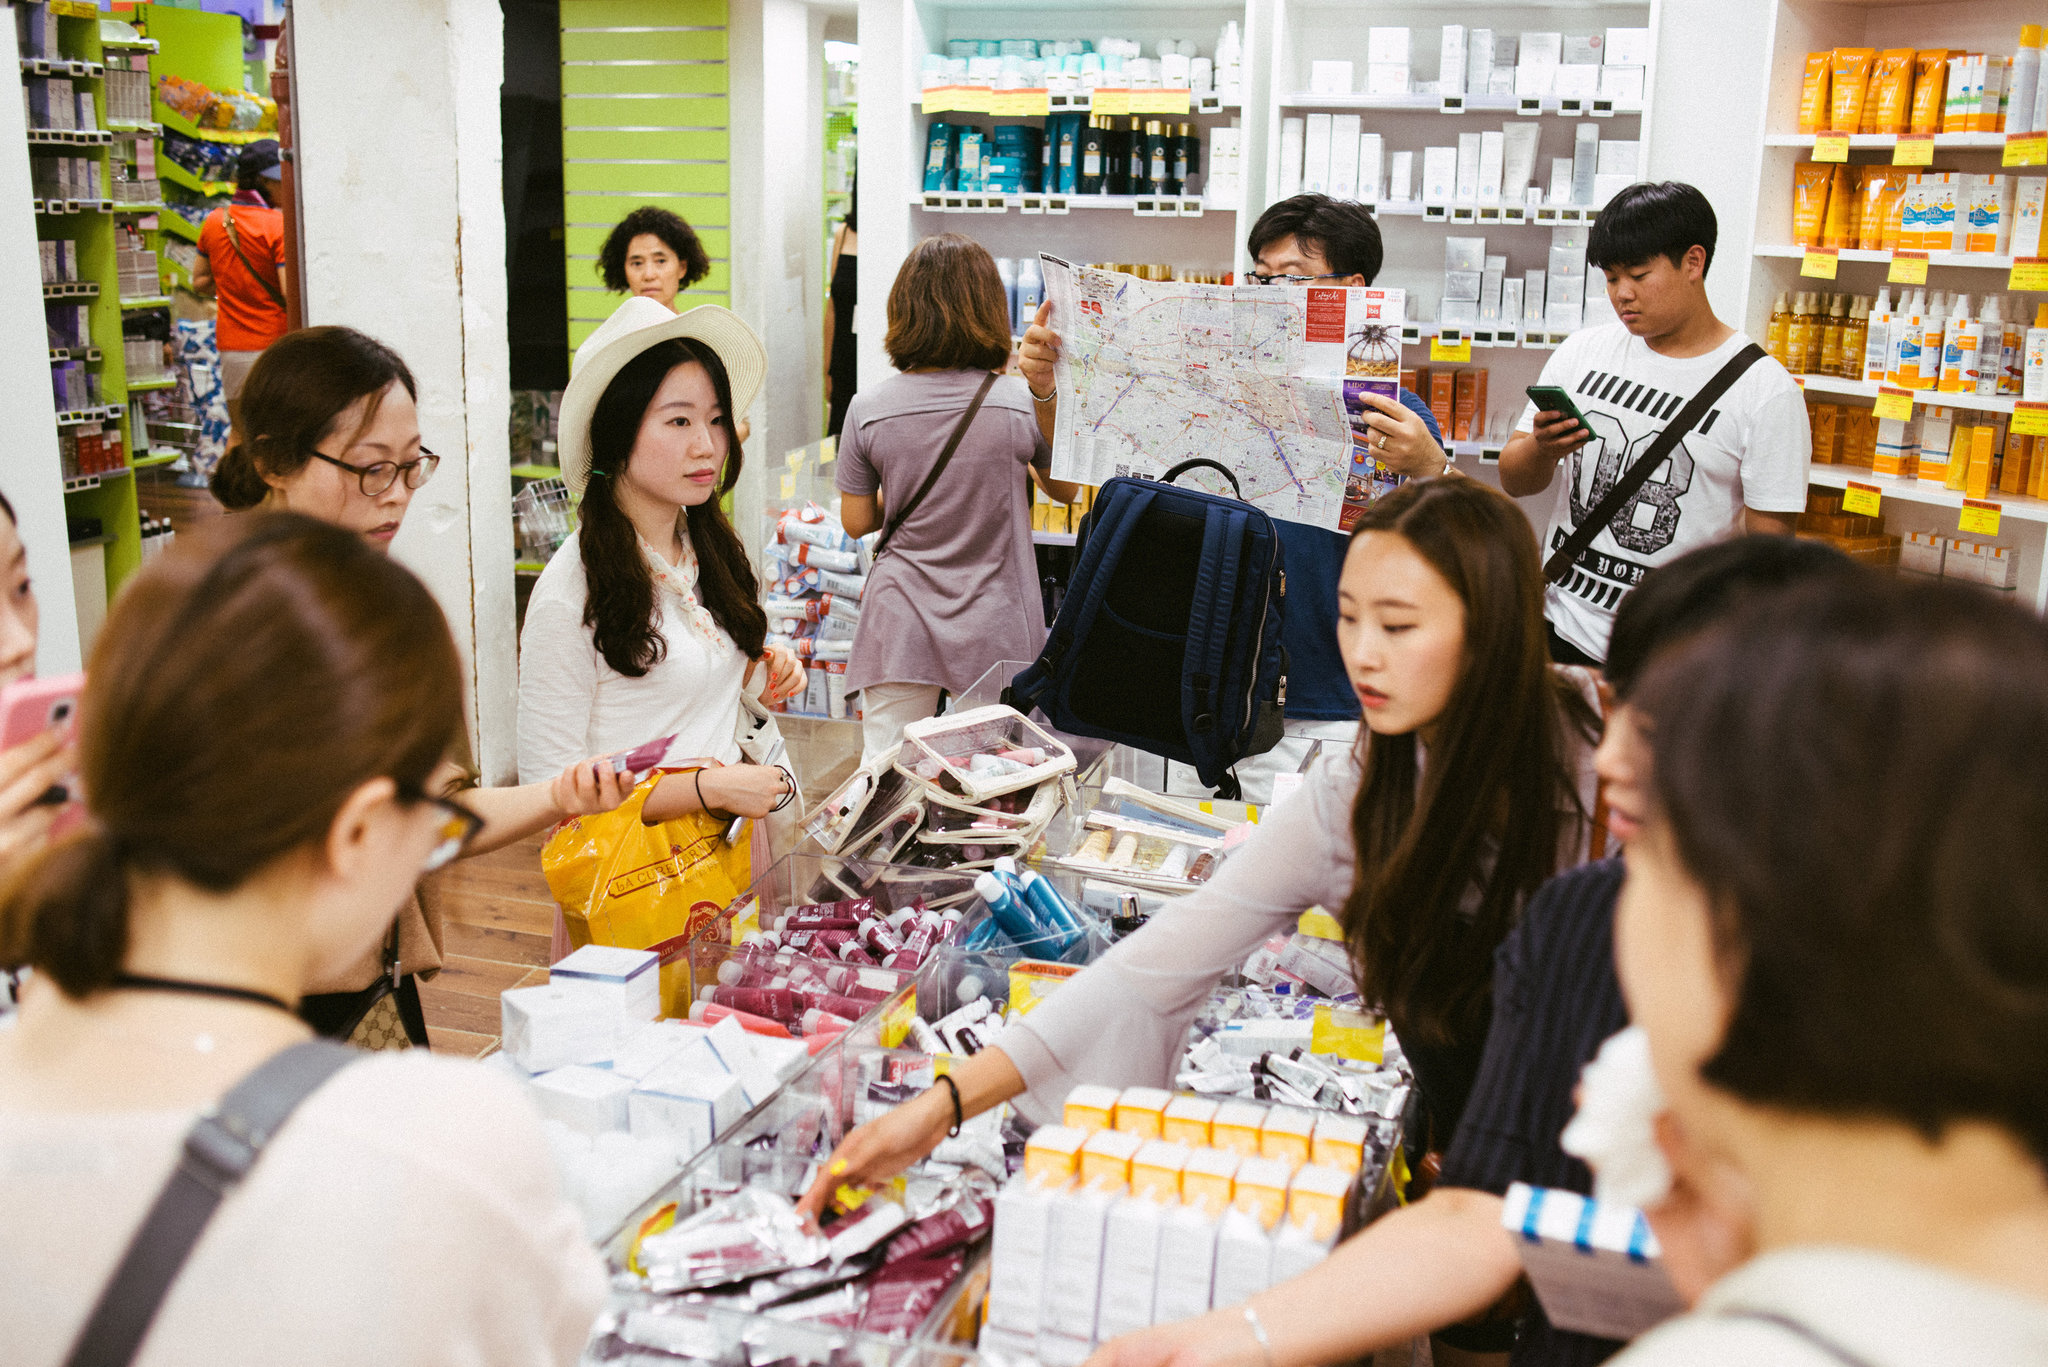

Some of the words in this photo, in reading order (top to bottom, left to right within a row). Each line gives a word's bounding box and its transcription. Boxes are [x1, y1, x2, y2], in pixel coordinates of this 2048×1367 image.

[1368, 306, 1379, 315] ibis
[615, 877, 634, 892] LA
[637, 863, 674, 884] CURE
[1028, 963, 1058, 976] NOTRE
